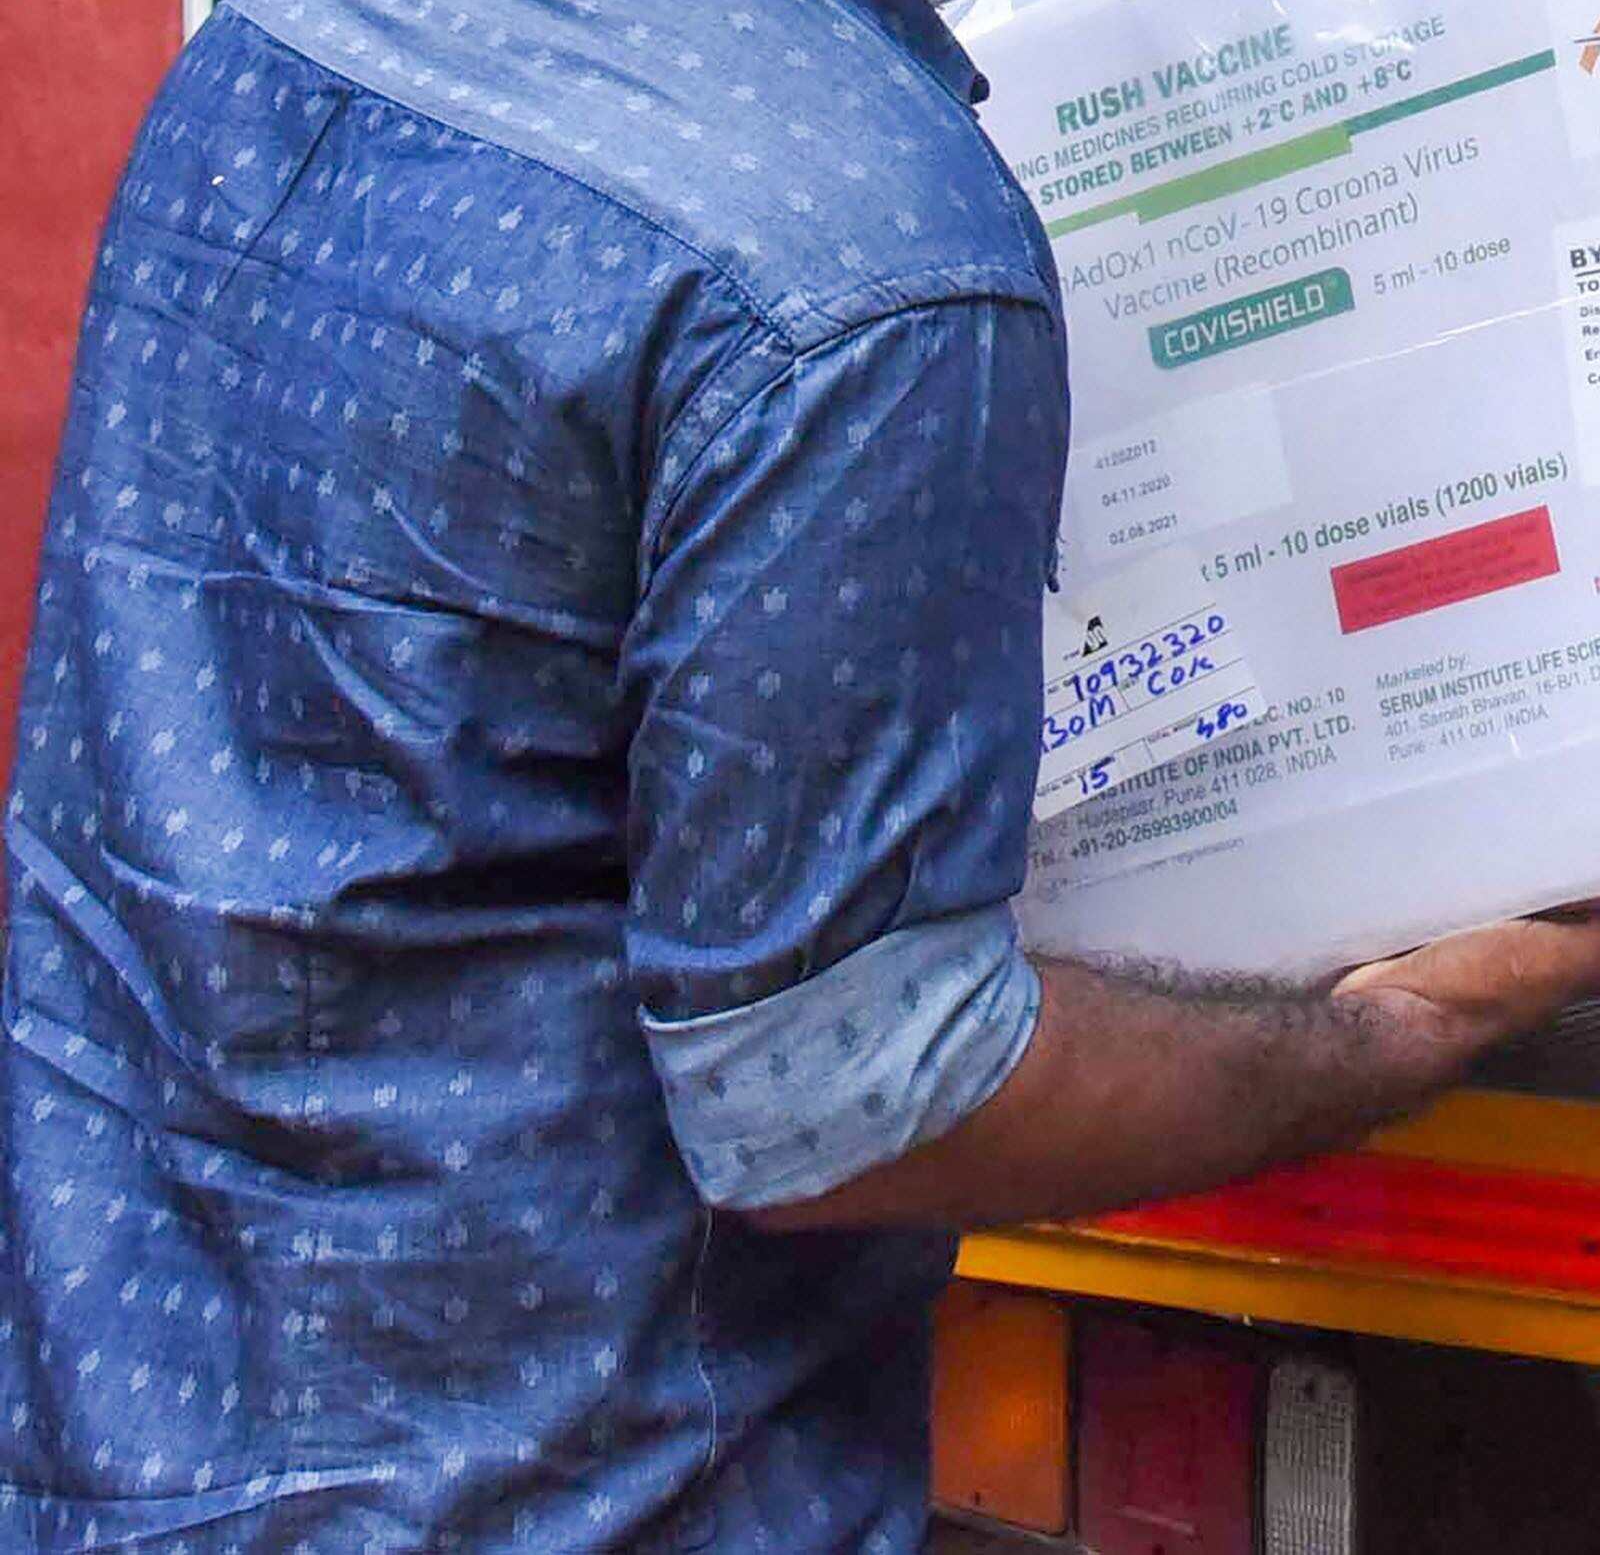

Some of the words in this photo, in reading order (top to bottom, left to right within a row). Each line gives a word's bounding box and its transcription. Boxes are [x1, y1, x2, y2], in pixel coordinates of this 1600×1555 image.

[1054, 116, 1161, 170] MEDICINES
[1165, 76, 1277, 129] REQUIRING
[1281, 53, 1338, 88] COLD
[1056, 76, 1146, 136] RUSH
[1152, 23, 1292, 98] VACCINE
[1039, 159, 1124, 206] STORED
[1130, 122, 1233, 174] BETWEEN
[1301, 82, 1348, 116] AND
[1296, 165, 1399, 215] Corona
[1404, 137, 1480, 178] Virus
[1103, 272, 1208, 321] Vaccine
[1215, 192, 1419, 287] (Recombinant)
[1164, 284, 1325, 358] COVISHIELD
[1373, 273, 1387, 296] 5
[1391, 264, 1416, 288] ml
[1434, 250, 1458, 275] 10
[1463, 237, 1511, 265] dose
[1215, 555, 1229, 578] 5
[1234, 544, 1263, 573] ml
[1282, 530, 1309, 558] 10
[1315, 516, 1371, 549] dose
[1375, 496, 1430, 529] vials
[1436, 472, 1498, 517] (1200
[1503, 451, 1568, 491] vials)
[1380, 687, 1438, 717] SERUM
[1441, 661, 1524, 700] INSTITUTE
[1526, 650, 1562, 676] LIFE
[1504, 704, 1549, 729] INDIA
[1184, 752, 1210, 776] OF
[1213, 740, 1264, 770] INDIA
[1268, 727, 1310, 754] PVT.
[1313, 715, 1356, 740] LTD.
[1211, 773, 1239, 795] 411
[1287, 745, 1337, 774] INDIA
